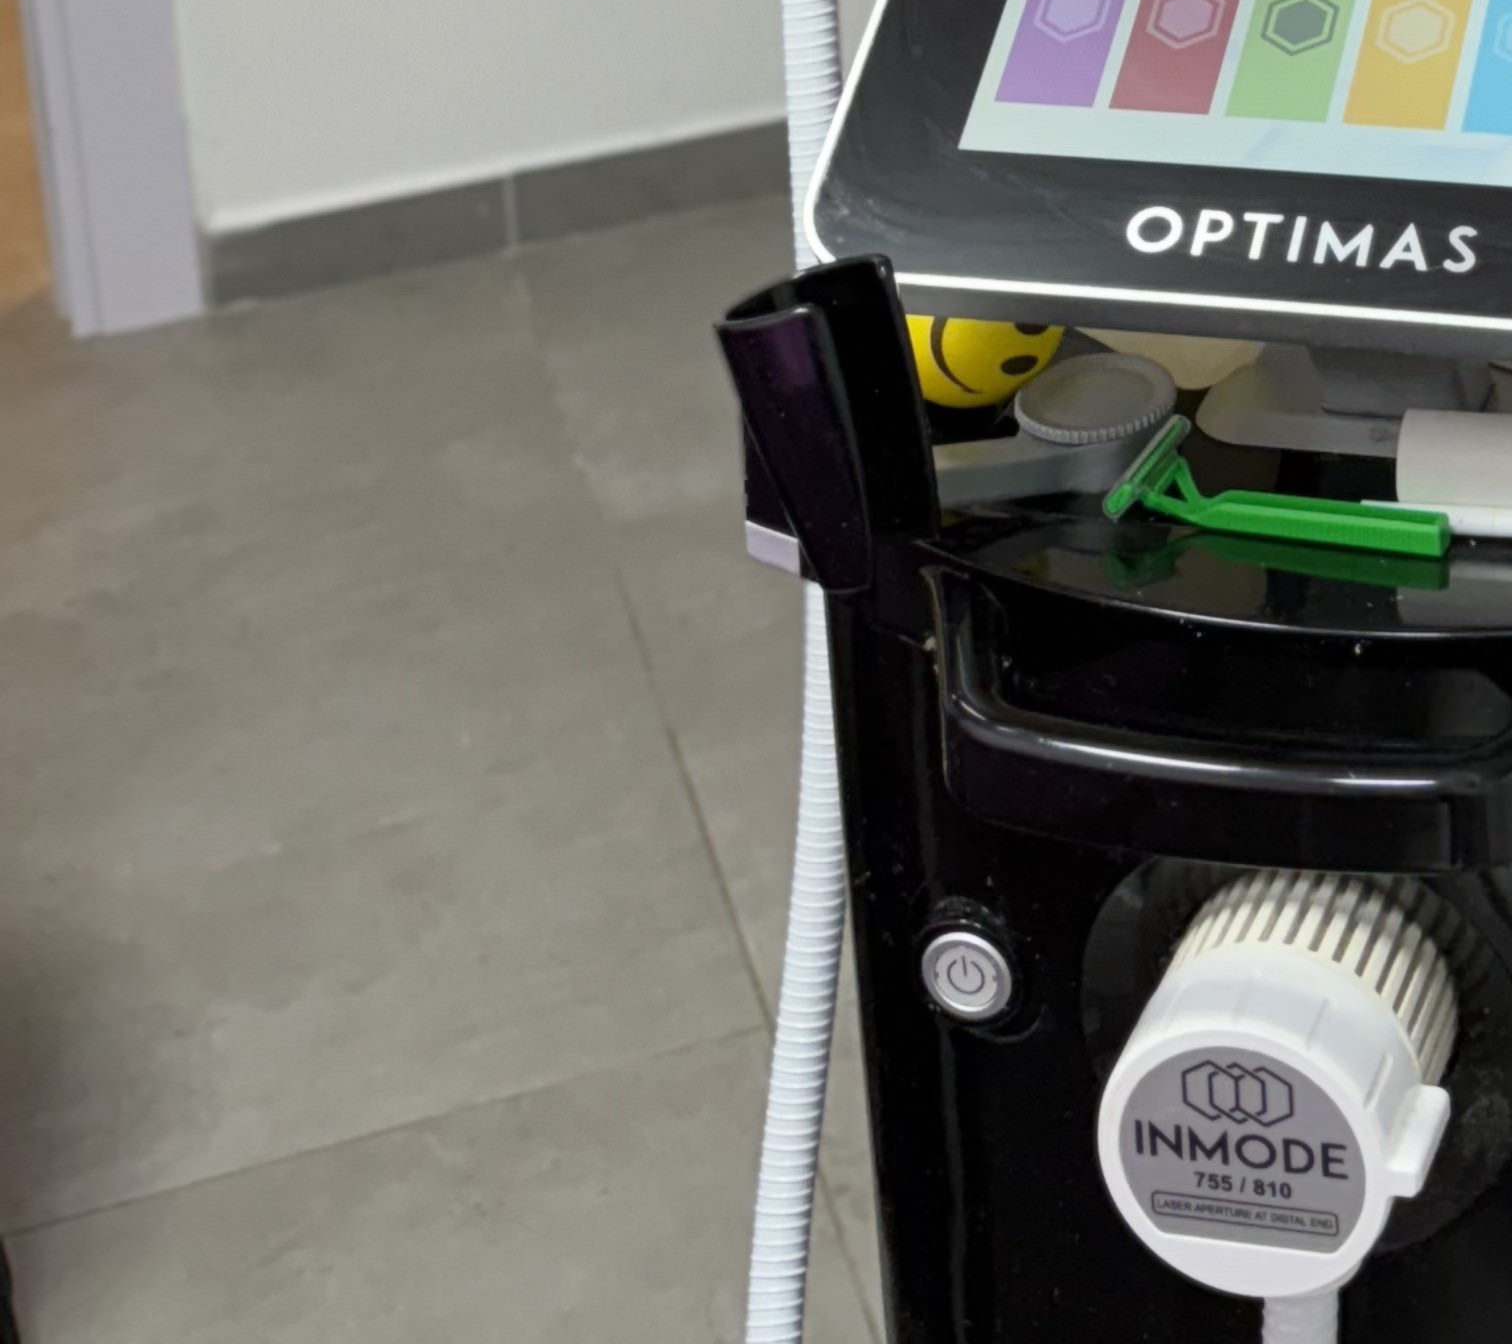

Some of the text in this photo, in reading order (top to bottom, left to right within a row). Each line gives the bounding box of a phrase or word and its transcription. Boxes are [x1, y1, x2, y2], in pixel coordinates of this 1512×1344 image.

[1126, 205, 1479, 273] OPTIMAS
[1134, 1118, 1349, 1181] INMODE
[1193, 1171, 1292, 1199] 755 / 810
[1156, 1199, 1193, 1212] LASER
[1194, 1203, 1250, 1220] APERTURE
[1255, 1210, 1269, 1222] AT
